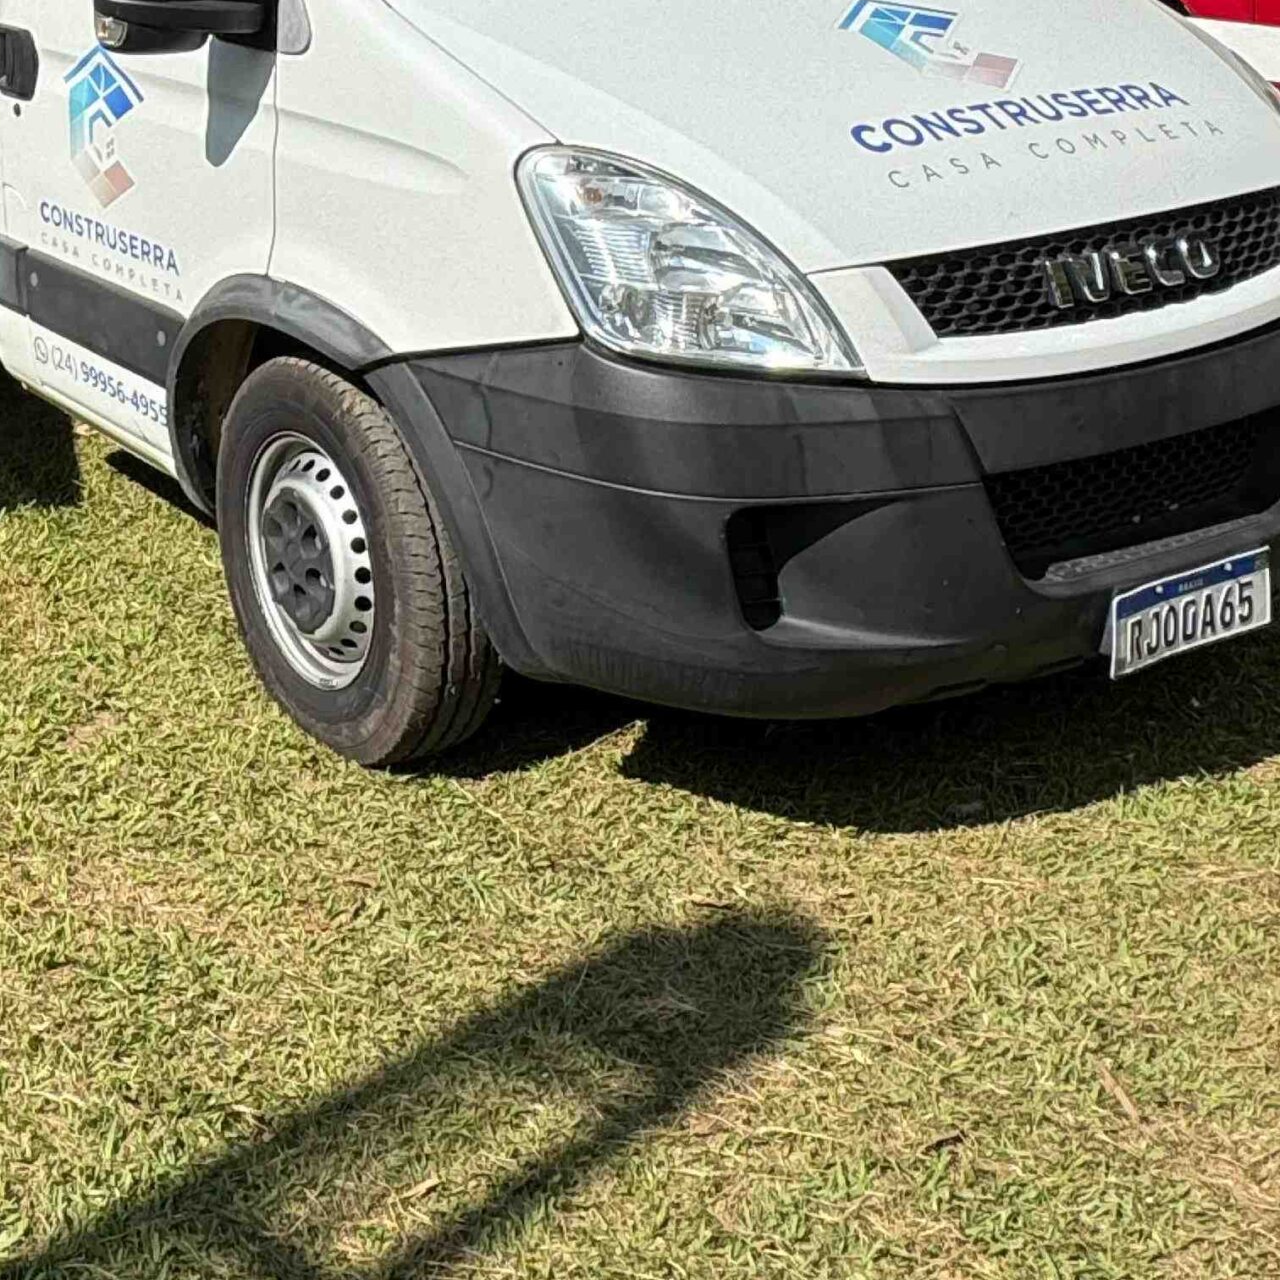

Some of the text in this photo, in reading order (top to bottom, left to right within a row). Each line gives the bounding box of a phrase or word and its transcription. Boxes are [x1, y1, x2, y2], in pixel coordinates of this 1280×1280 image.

[851, 81, 1189, 153] CONSTRUSERRA
[888, 119, 1223, 188] CASA COMPLETA
[40, 201, 180, 277] CONSTRUSERRA
[40, 232, 184, 303] CASA COMPLETA
[1044, 238, 1221, 309] IVECO
[52, 345, 168, 427] (24) 99956-4955
